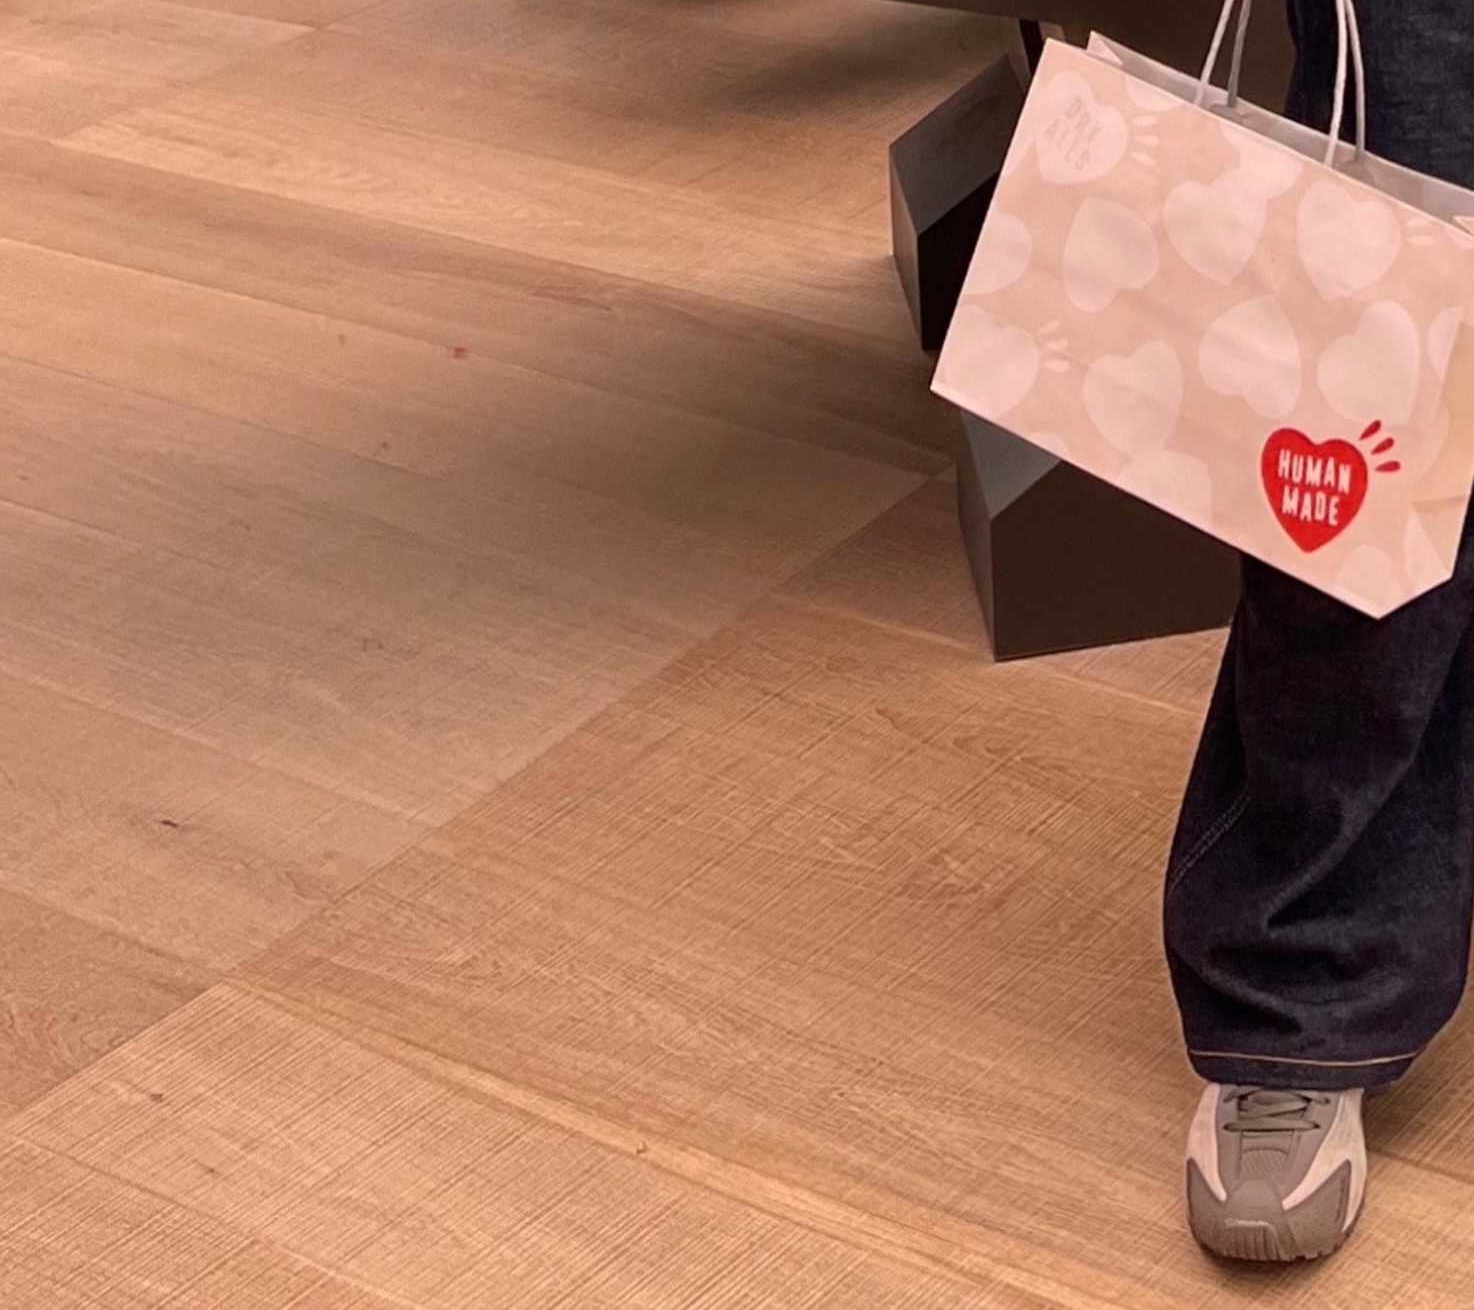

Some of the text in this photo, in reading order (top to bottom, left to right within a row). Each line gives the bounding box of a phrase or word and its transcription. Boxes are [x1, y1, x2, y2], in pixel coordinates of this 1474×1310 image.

[1066, 97, 1100, 141] DRY
[1278, 448, 1351, 494] HUMAN
[1281, 484, 1340, 526] MADE
